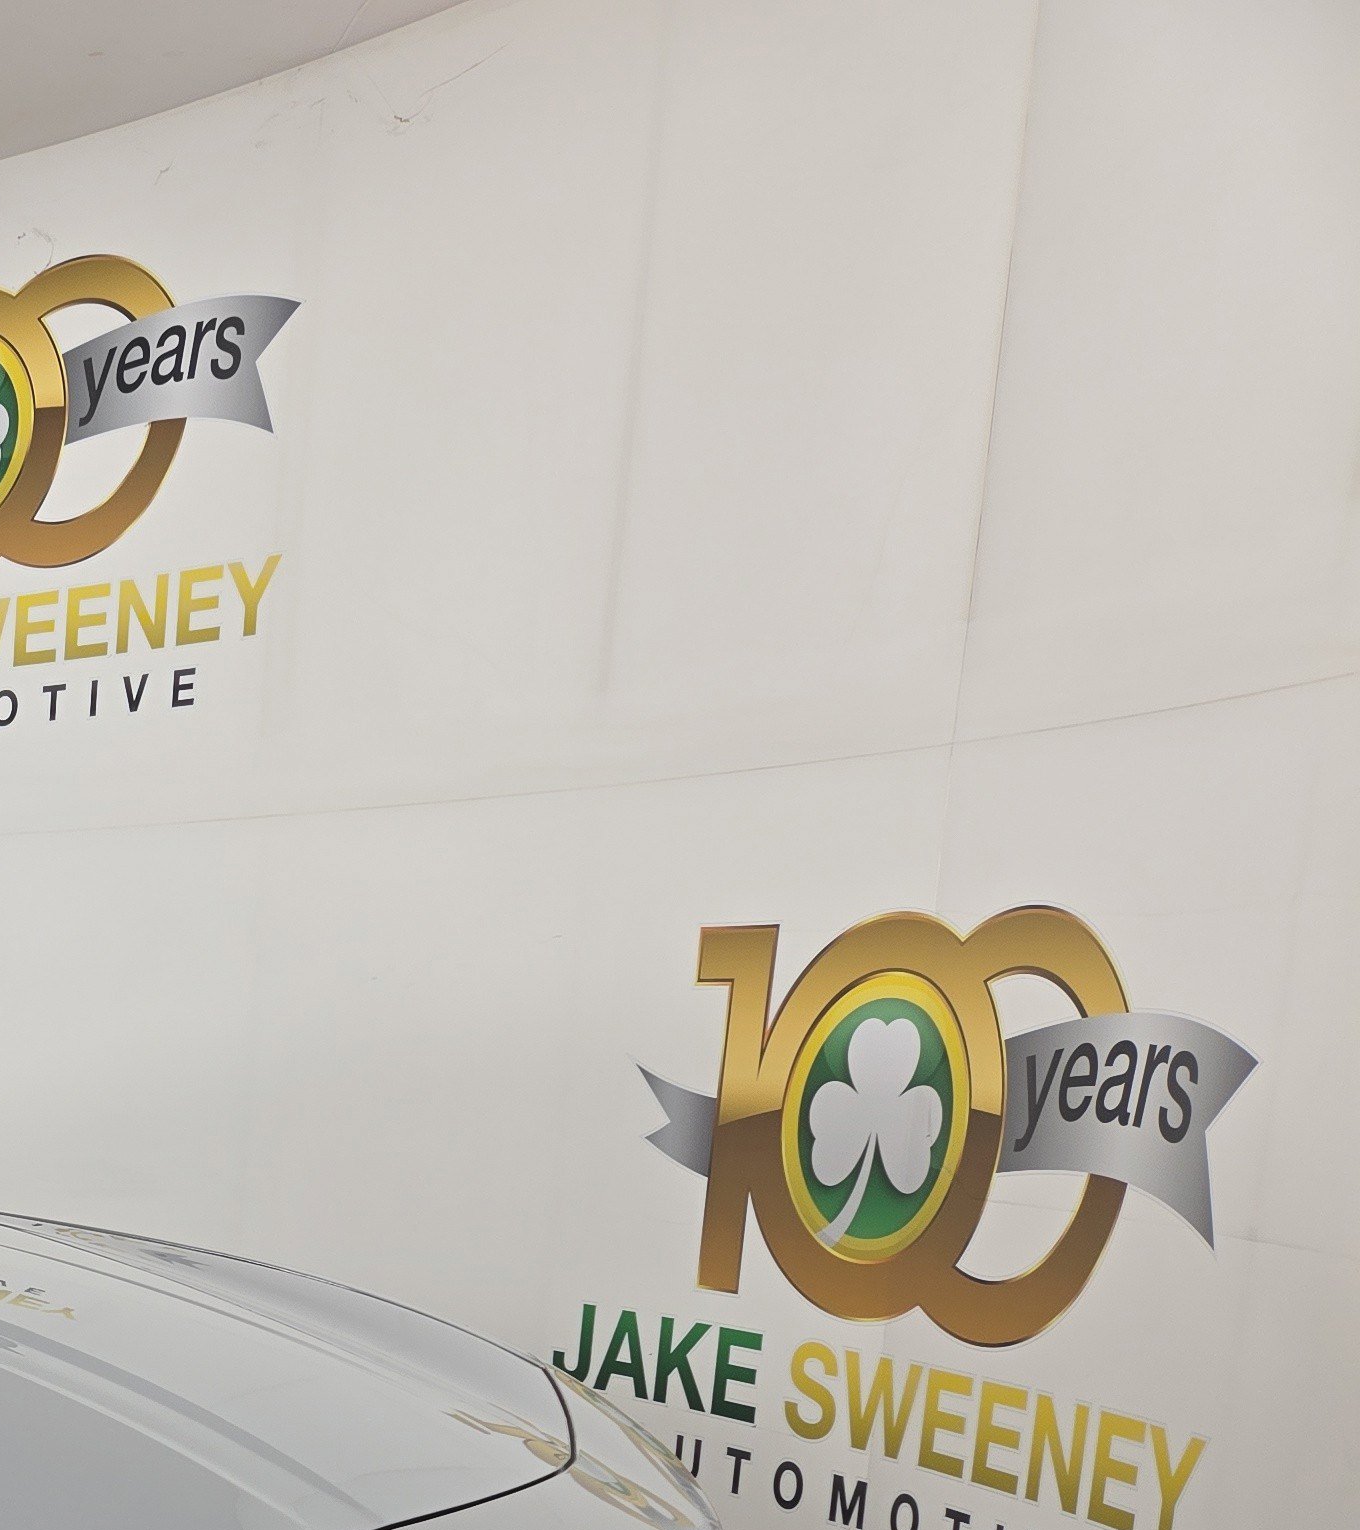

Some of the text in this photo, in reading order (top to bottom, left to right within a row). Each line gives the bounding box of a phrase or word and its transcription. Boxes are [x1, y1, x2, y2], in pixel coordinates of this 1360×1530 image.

[79, 315, 246, 427] years
[1011, 1038, 1199, 1153] years
[552, 1303, 764, 1424] JAKE
